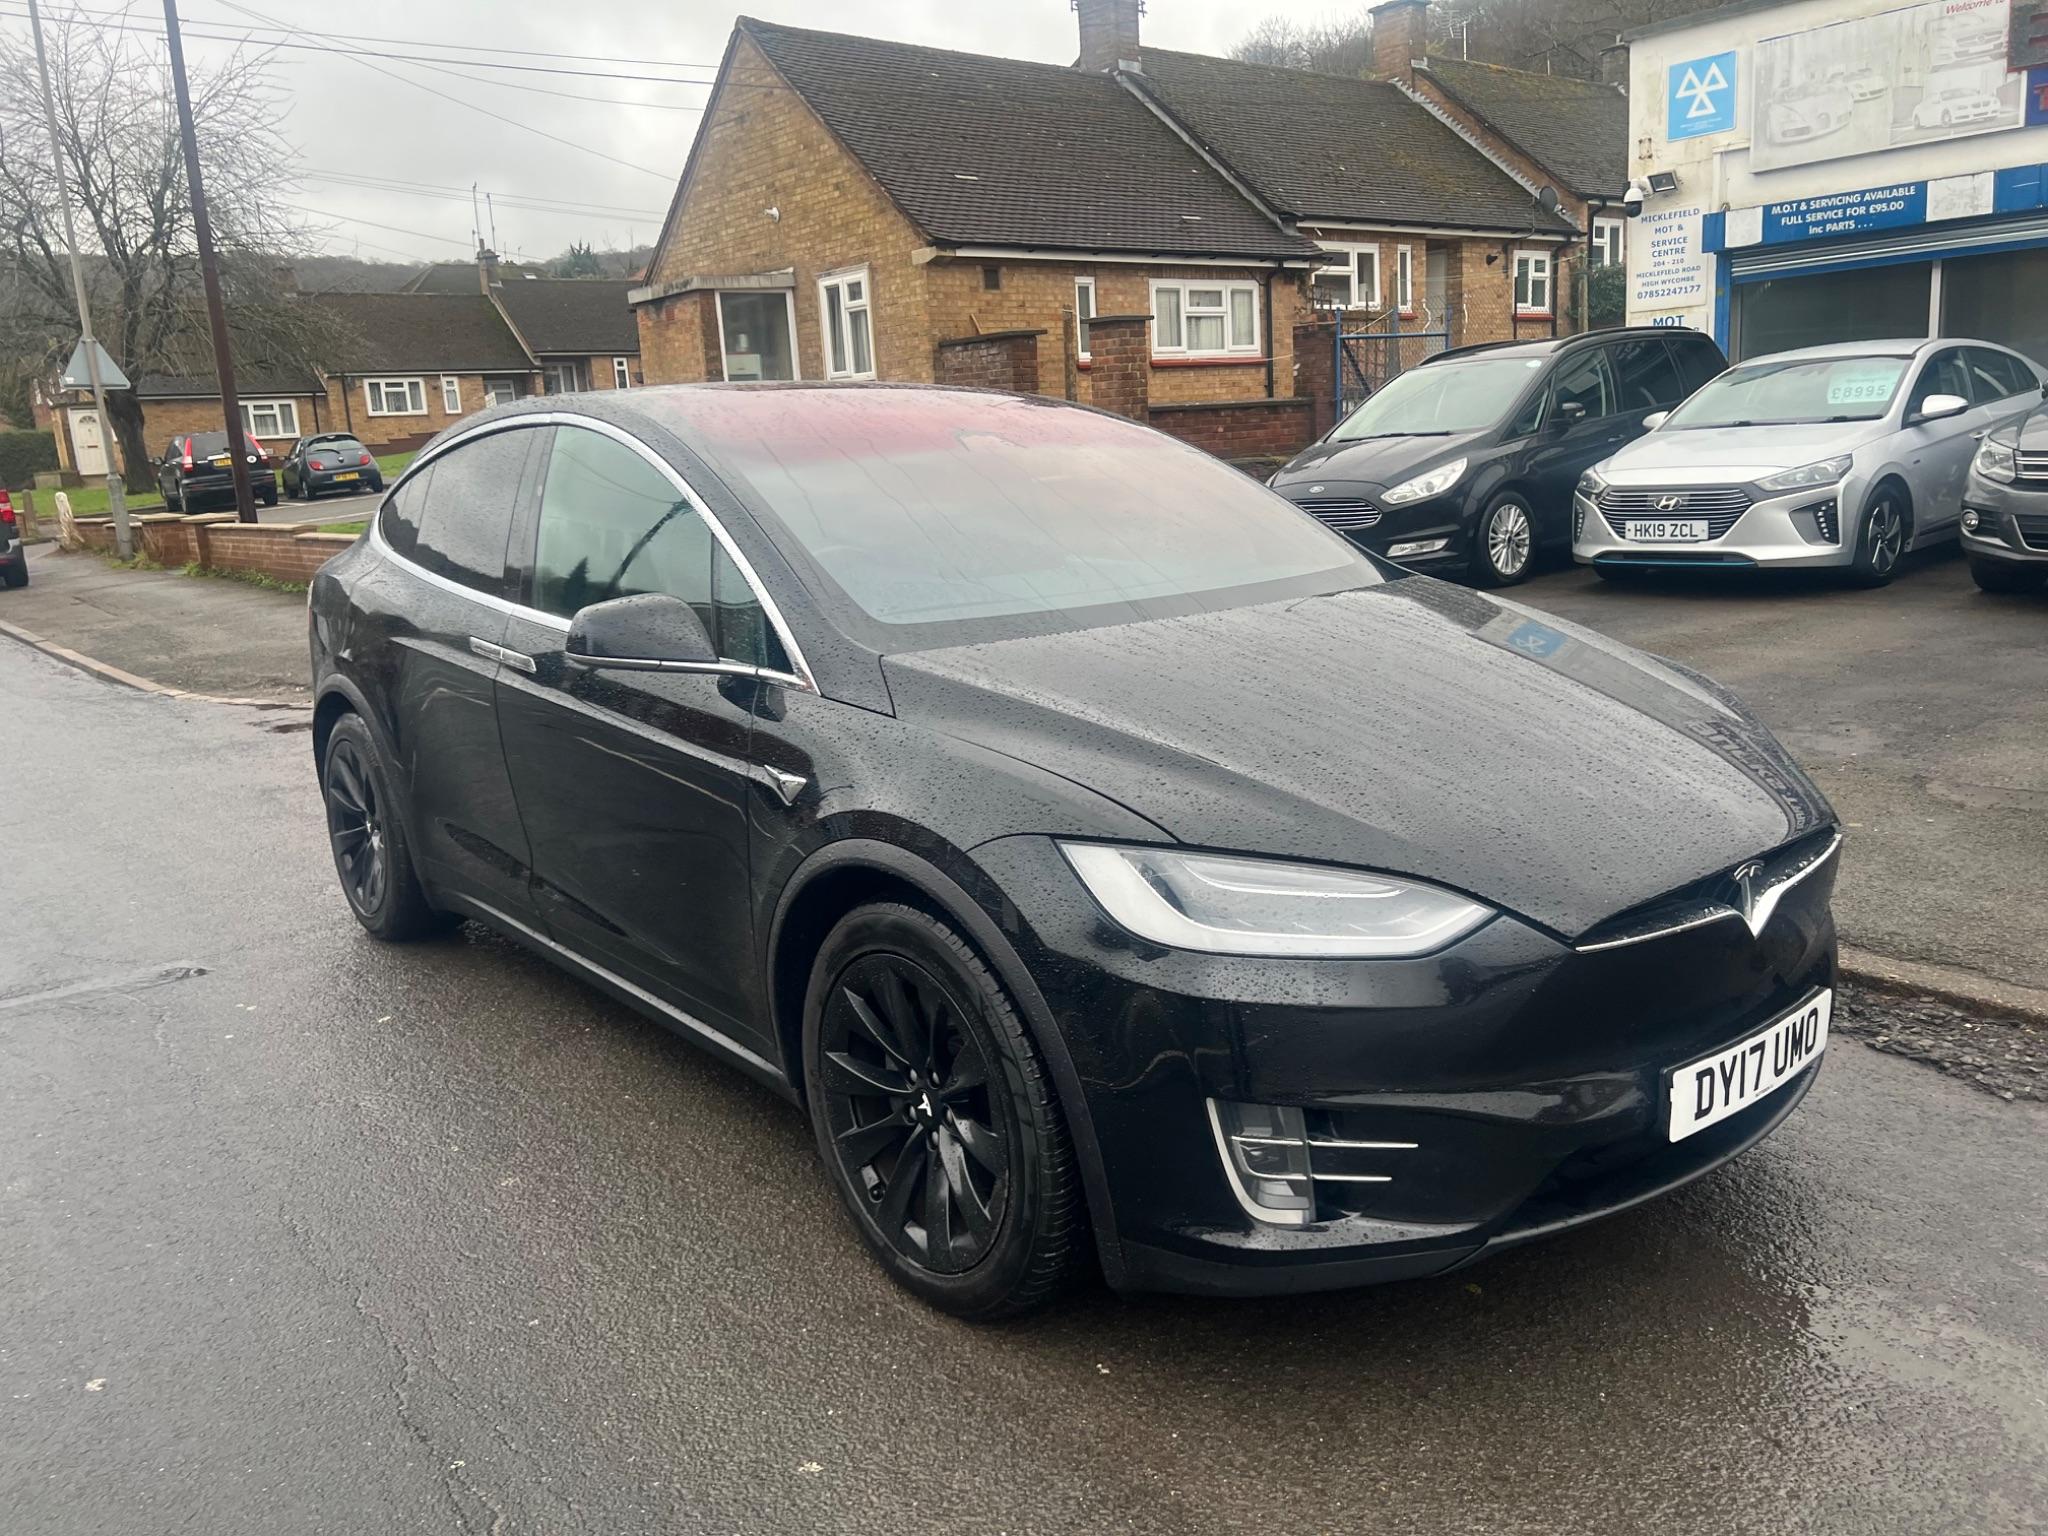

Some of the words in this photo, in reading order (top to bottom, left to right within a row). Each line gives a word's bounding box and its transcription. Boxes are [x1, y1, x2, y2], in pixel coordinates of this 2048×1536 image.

[1771, 202, 1797, 215] M.O.T
[1799, 201, 1807, 211] &
[1809, 194, 1861, 210] SERVICING
[1863, 186, 1916, 202] AVAILABLE
[1640, 208, 1700, 224] MICKLEFIELD
[1781, 215, 1803, 226] FULL
[1805, 209, 1844, 223] SERVICE
[1846, 205, 1866, 217] FOR
[1869, 200, 1905, 214] £95.00
[1654, 225, 1673, 235] MOT
[1677, 223, 1684, 231] &
[1826, 220, 1855, 233] PARTS
[1651, 236, 1688, 248] SERVICE
[1652, 246, 1686, 258] CENTRE
[1636, 268, 1680, 279] MICKLEFIELD
[1682, 265, 1701, 273] ROAD
[1661, 276, 1695, 285] WYCOMBE
[1637, 284, 1701, 299] 07852247177
[1653, 315, 1685, 327] MOT
[1831, 385, 1887, 399] £8995
[1634, 523, 1665, 537] HK19
[1670, 523, 1698, 537] ZCL
[1694, 1040, 1766, 1121] DY17
[1773, 1007, 1818, 1078] UMO
